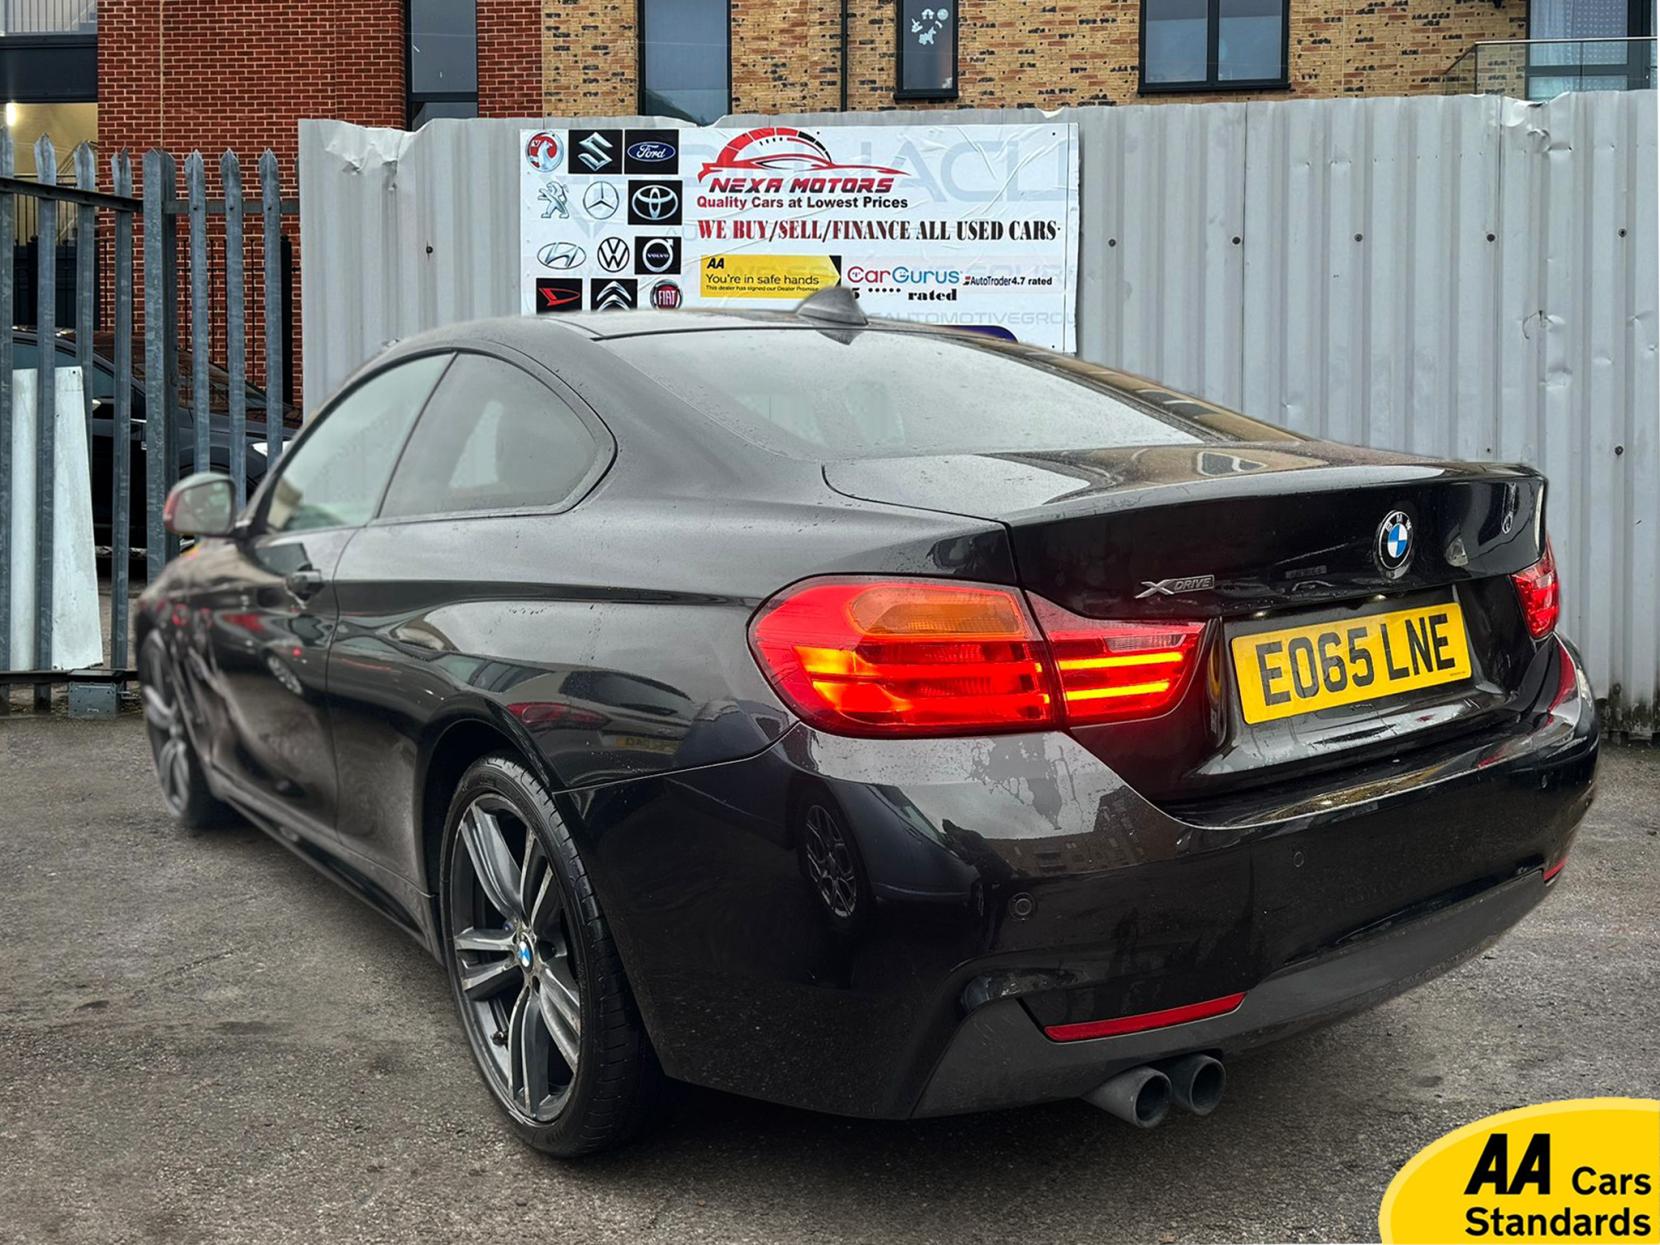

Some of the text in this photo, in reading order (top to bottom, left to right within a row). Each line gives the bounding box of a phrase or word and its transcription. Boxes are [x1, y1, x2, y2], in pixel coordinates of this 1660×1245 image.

[637, 143, 666, 159] Ford
[709, 178, 894, 193] NEXA MOTORS
[697, 197, 908, 210] Quality Cars at Lowest Prices
[697, 220, 727, 239] WE
[916, 221, 950, 240] ALL
[956, 221, 1003, 240] USED
[1009, 221, 1056, 240] CARS
[706, 257, 724, 269] AA
[706, 274, 820, 285] You're in safe hands
[847, 266, 960, 284] CarGurus
[1011, 276, 1026, 286] 4.7
[1028, 277, 1053, 286] rated
[658, 290, 675, 306] FIAT
[908, 288, 957, 301] rated
[1380, 613, 1456, 680] LNE
